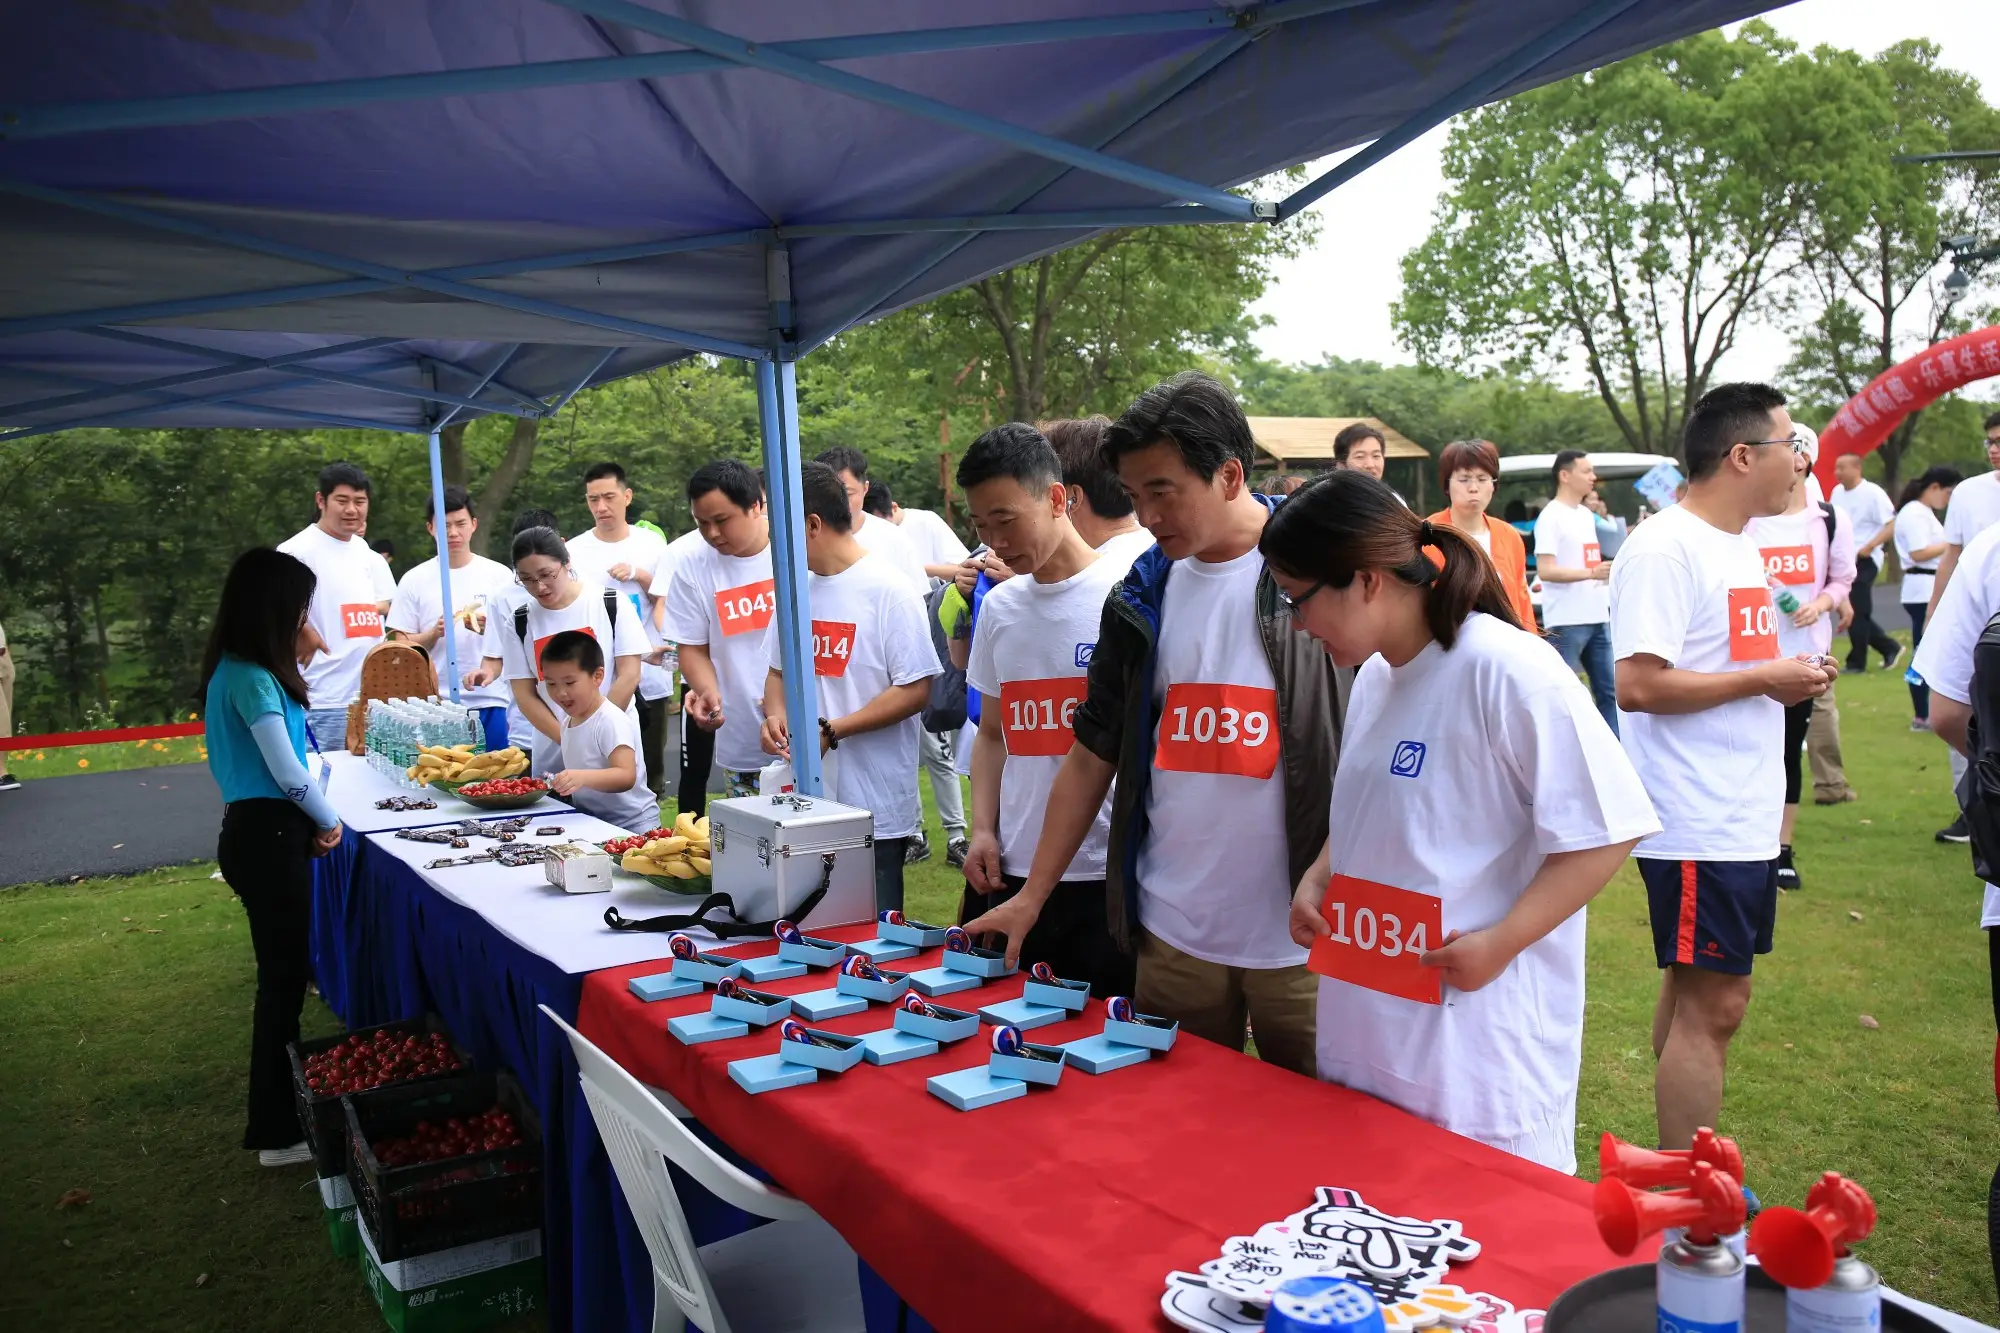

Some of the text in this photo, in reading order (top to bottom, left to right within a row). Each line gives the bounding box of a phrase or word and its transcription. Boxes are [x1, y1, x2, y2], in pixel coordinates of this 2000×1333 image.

[347, 611, 379, 627] 1035
[724, 590, 775, 620] 1041
[812, 634, 848, 660] 014
[1010, 697, 1078, 731] 1016
[1171, 706, 1269, 747] 1039
[1330, 902, 1426, 957] 1034
